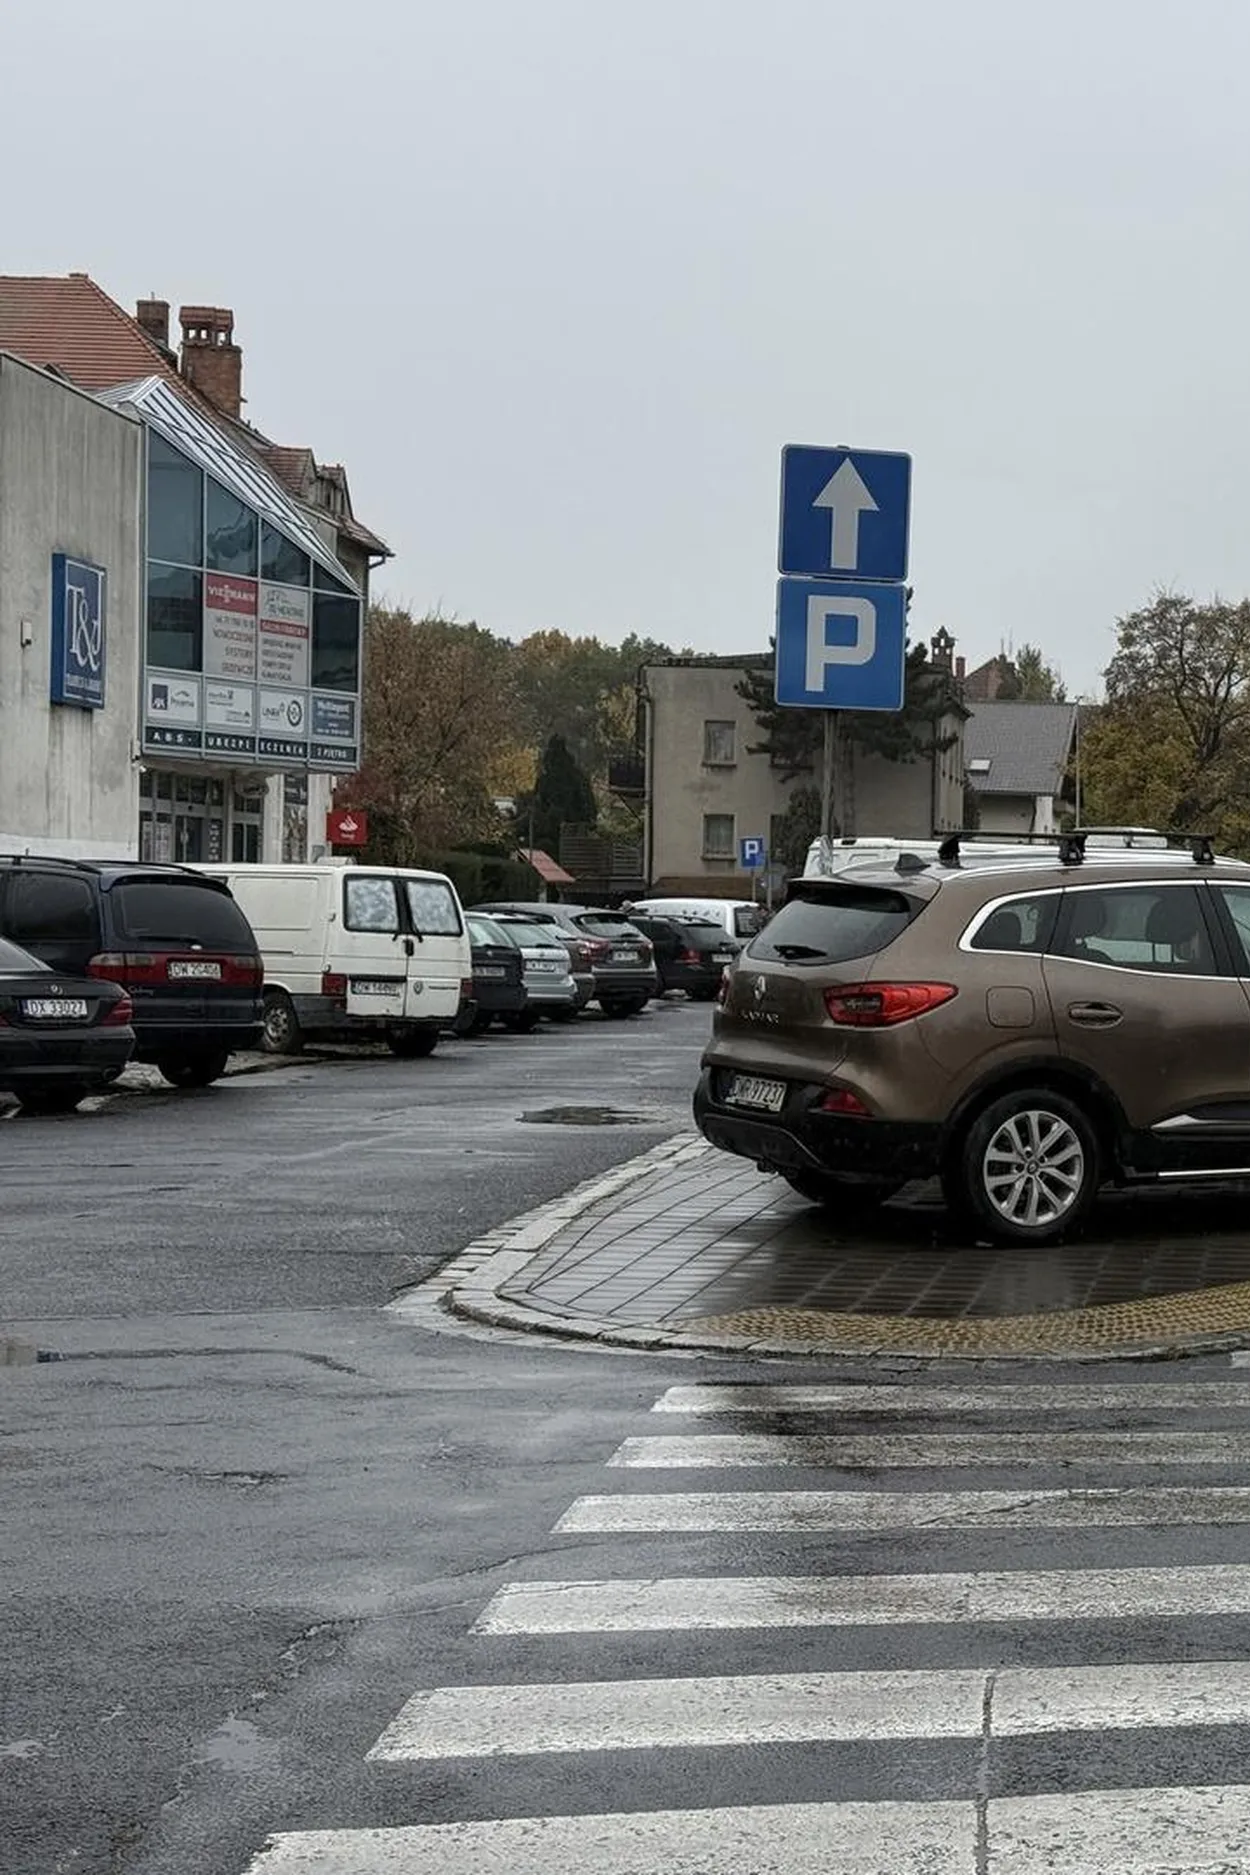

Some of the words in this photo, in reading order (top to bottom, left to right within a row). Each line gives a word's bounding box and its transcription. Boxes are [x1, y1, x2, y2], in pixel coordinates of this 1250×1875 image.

[805, 595, 877, 692] P
[745, 840, 759, 860] P
[29, 1001, 45, 1013] DX
